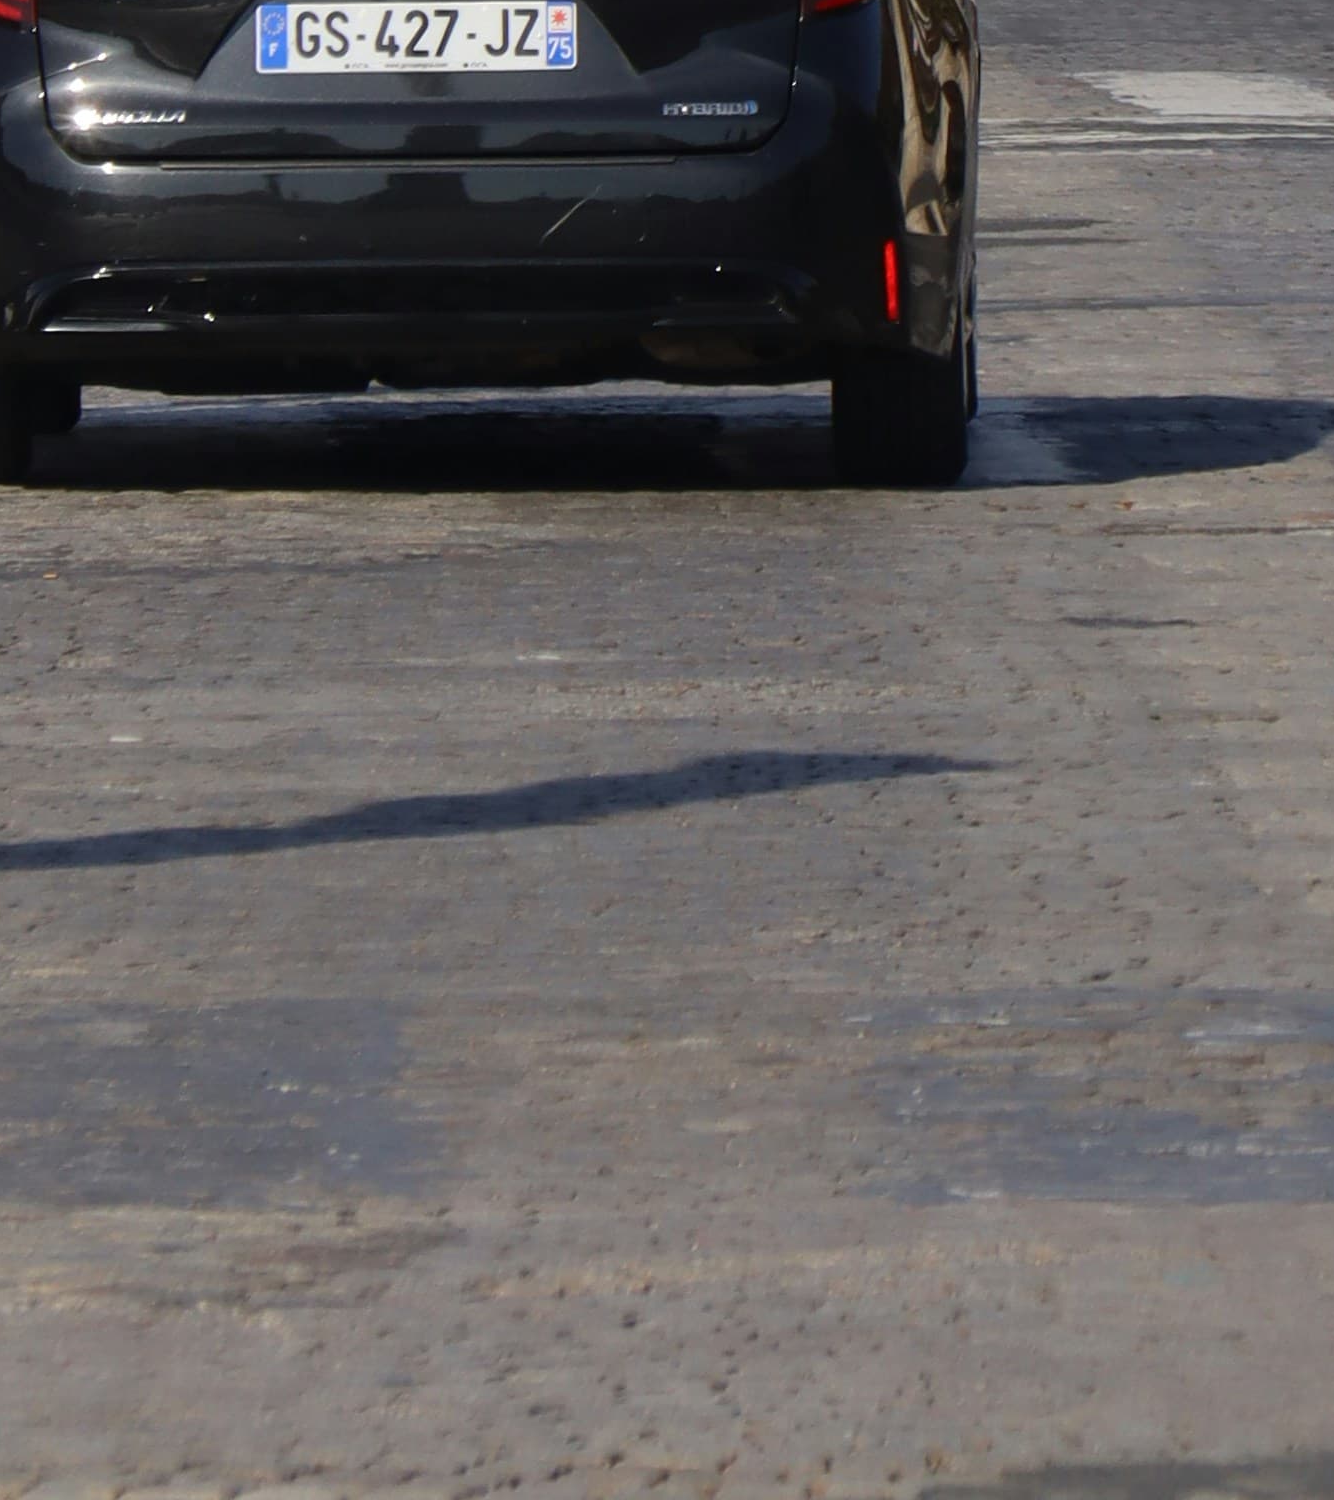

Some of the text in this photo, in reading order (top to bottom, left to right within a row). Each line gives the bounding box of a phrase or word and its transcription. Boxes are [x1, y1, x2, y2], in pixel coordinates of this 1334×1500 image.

[269, 8, 573, 60] F GS-427-JZ 75
